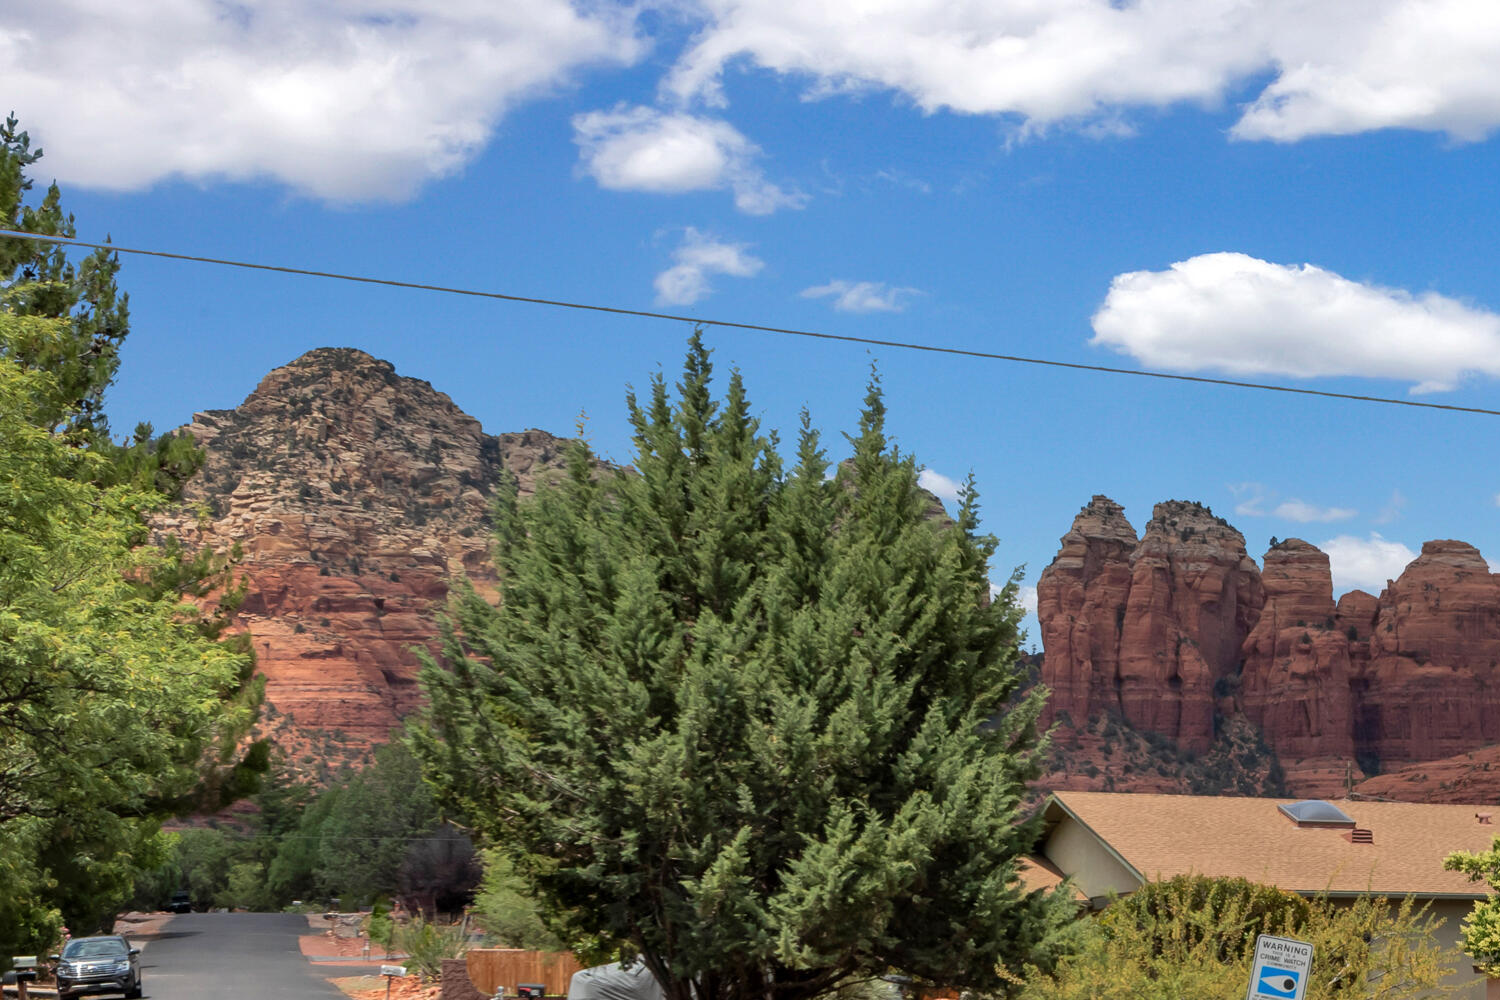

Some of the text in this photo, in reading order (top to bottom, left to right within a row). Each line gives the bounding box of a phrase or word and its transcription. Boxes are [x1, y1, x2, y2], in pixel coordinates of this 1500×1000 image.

[1263, 941, 1308, 956] WARNING
[1260, 953, 1306, 967] CRIME WATCH
